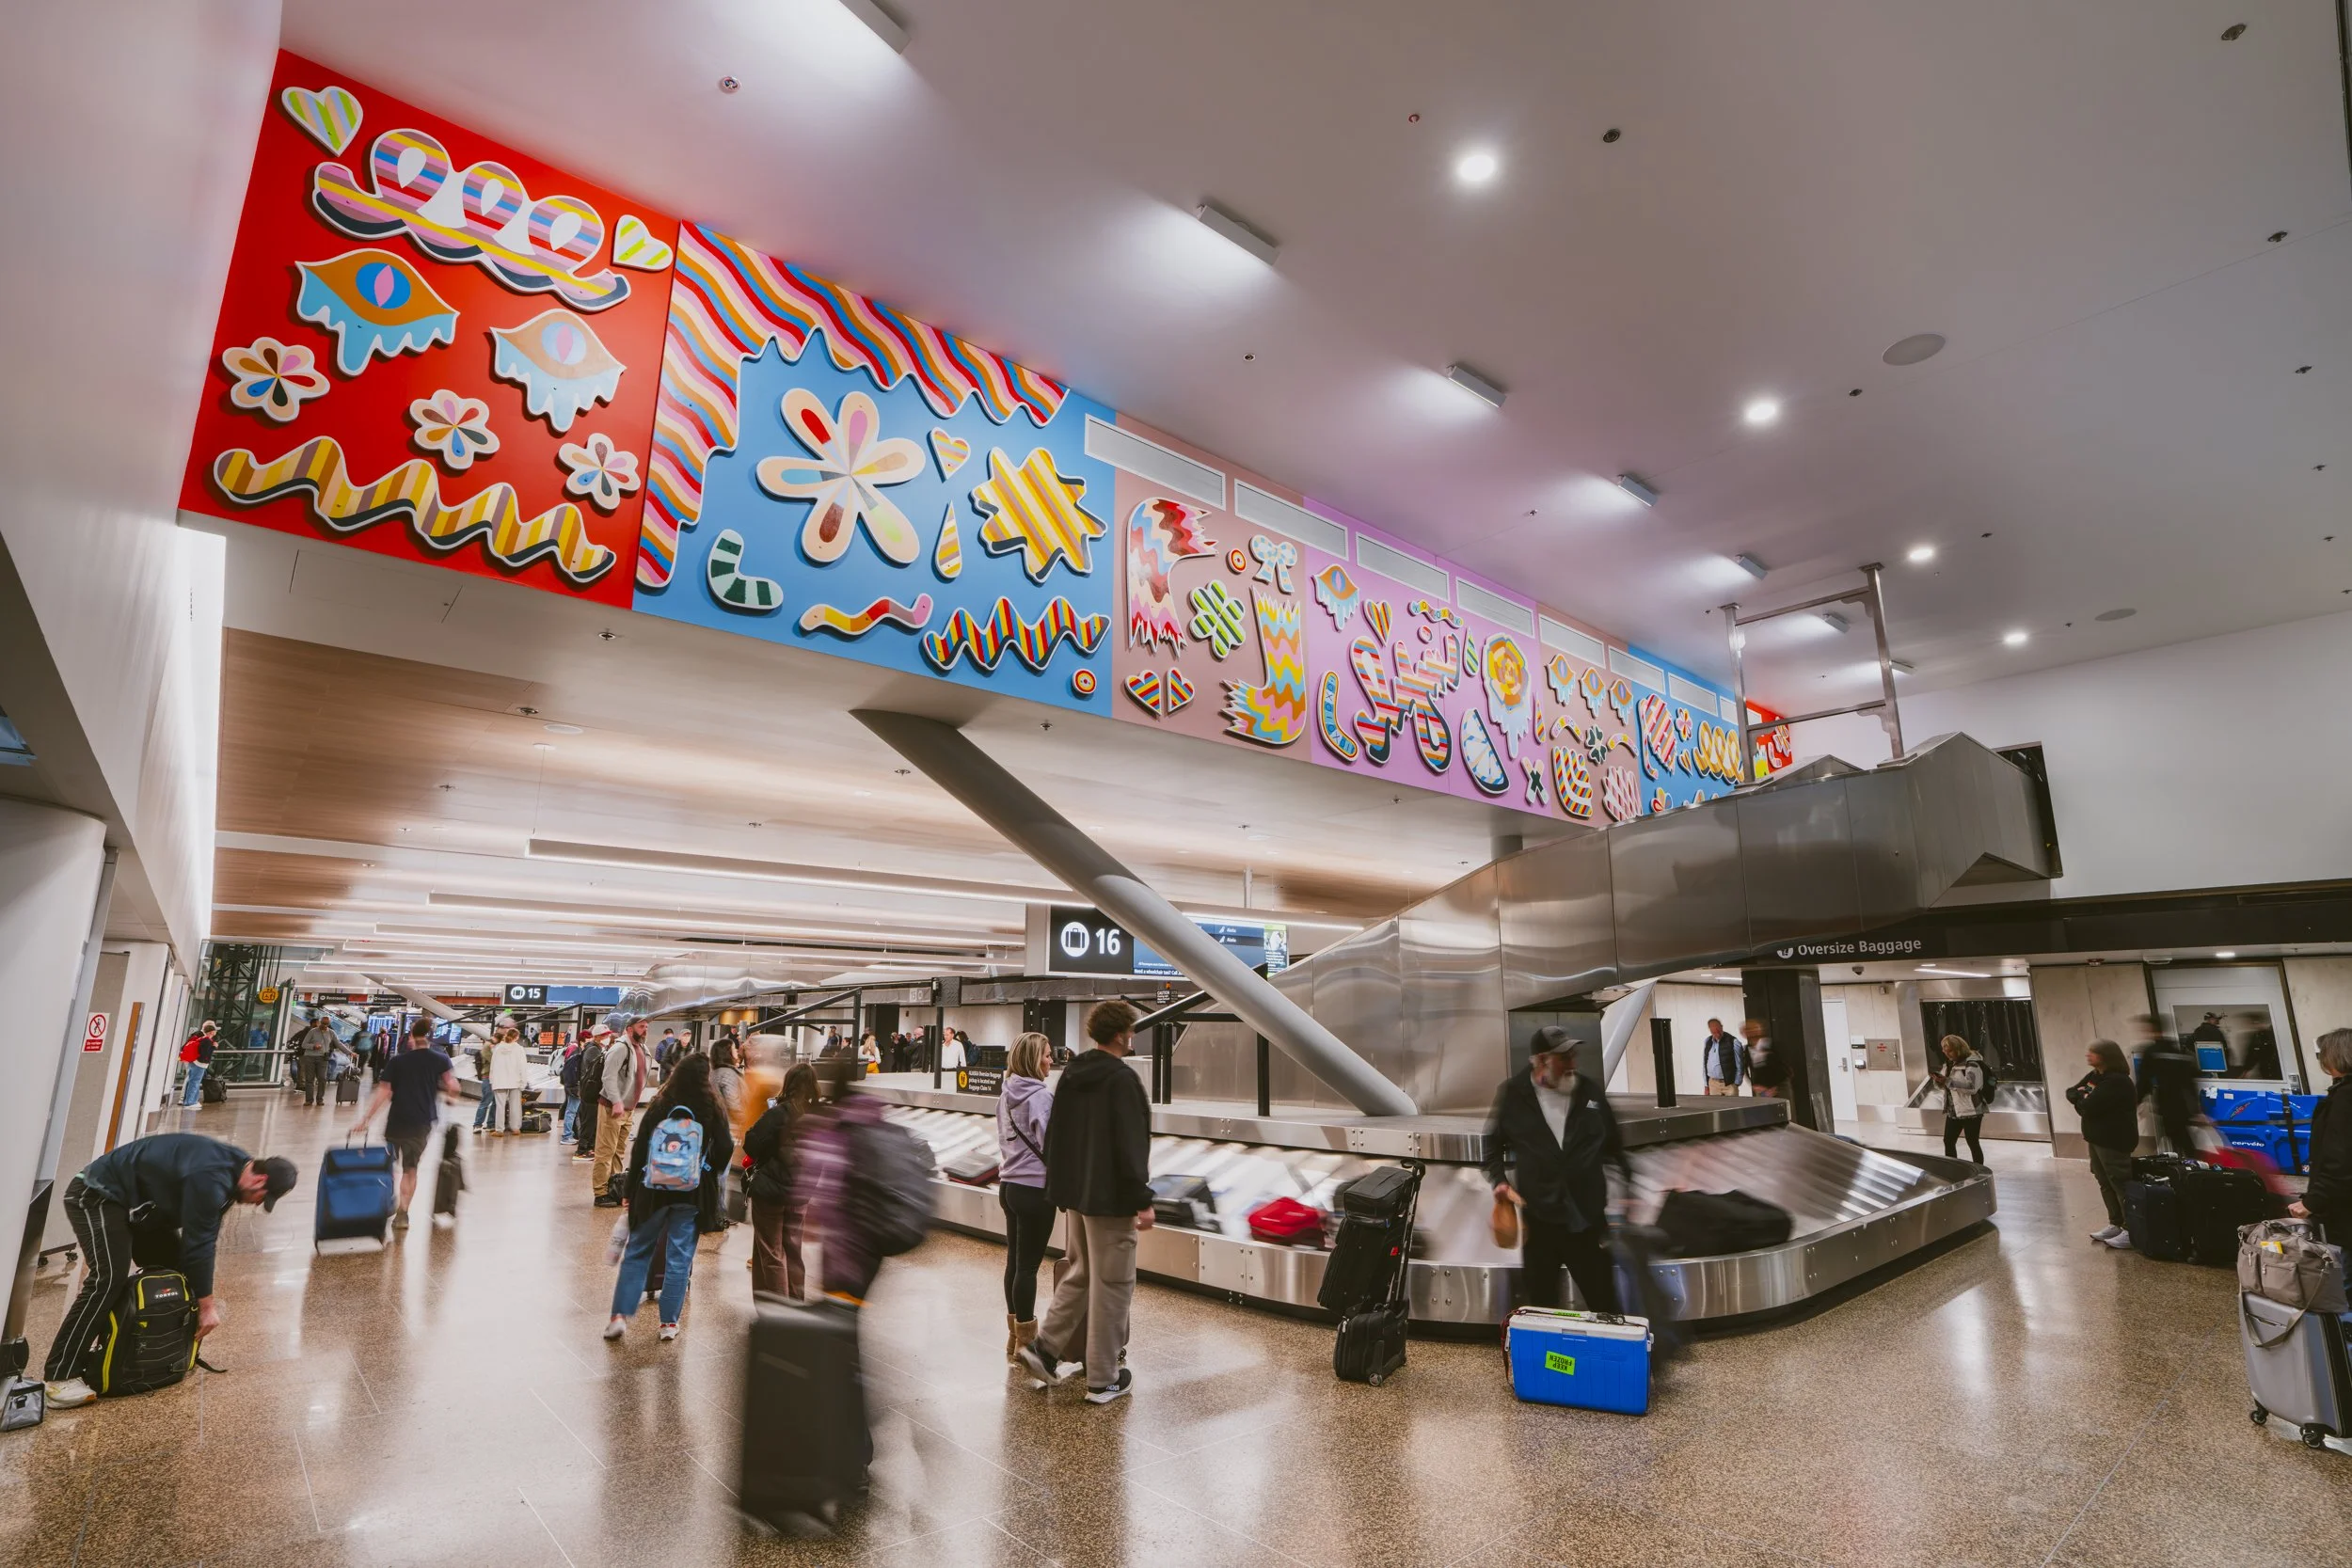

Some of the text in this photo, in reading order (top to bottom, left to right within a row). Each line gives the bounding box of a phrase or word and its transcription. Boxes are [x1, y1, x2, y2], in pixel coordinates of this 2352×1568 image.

[1095, 927, 1120, 955] 16
[1798, 940, 1922, 956] Oversize Baggage
[528, 988, 541, 999] 15
[1549, 1354, 1572, 1366] FROZEN
[1552, 1362, 1568, 1371] KEEP
